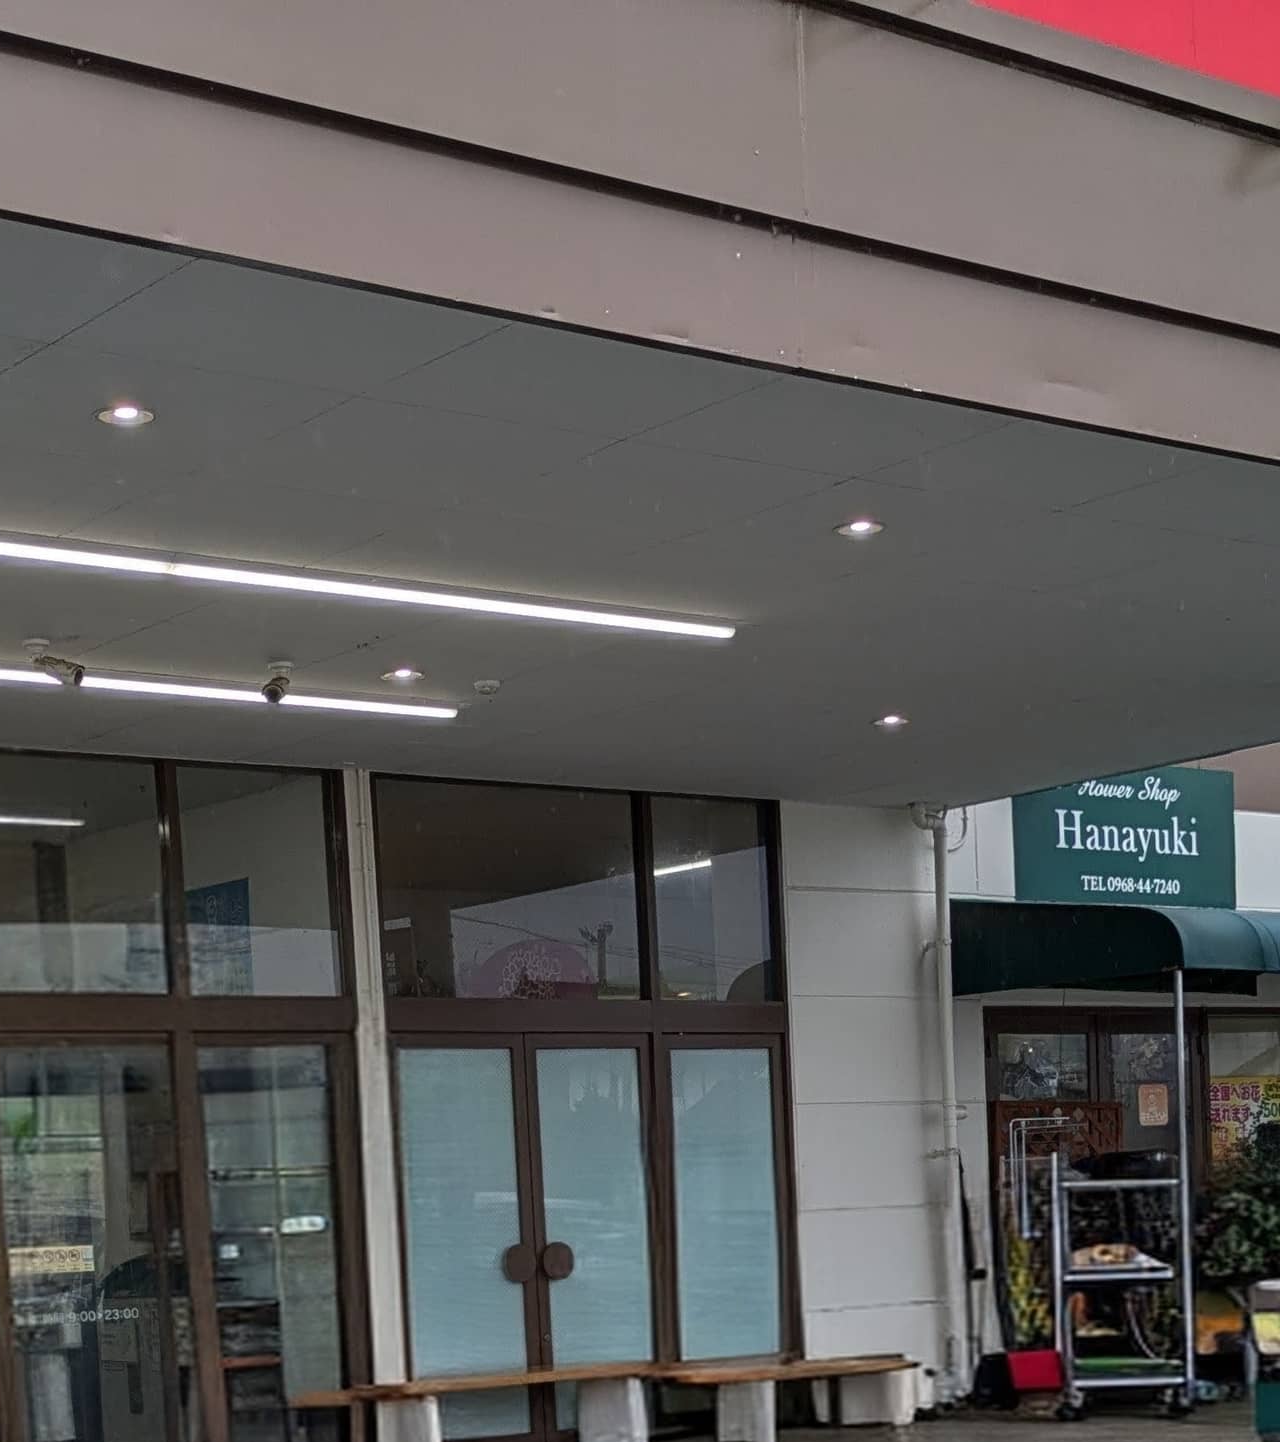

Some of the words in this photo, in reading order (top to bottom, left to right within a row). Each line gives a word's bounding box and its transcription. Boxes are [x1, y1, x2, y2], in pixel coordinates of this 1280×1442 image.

[1138, 776, 1181, 810] Shop
[1055, 808, 1200, 862] Hanayuki
[1081, 875, 1106, 892] TEL
